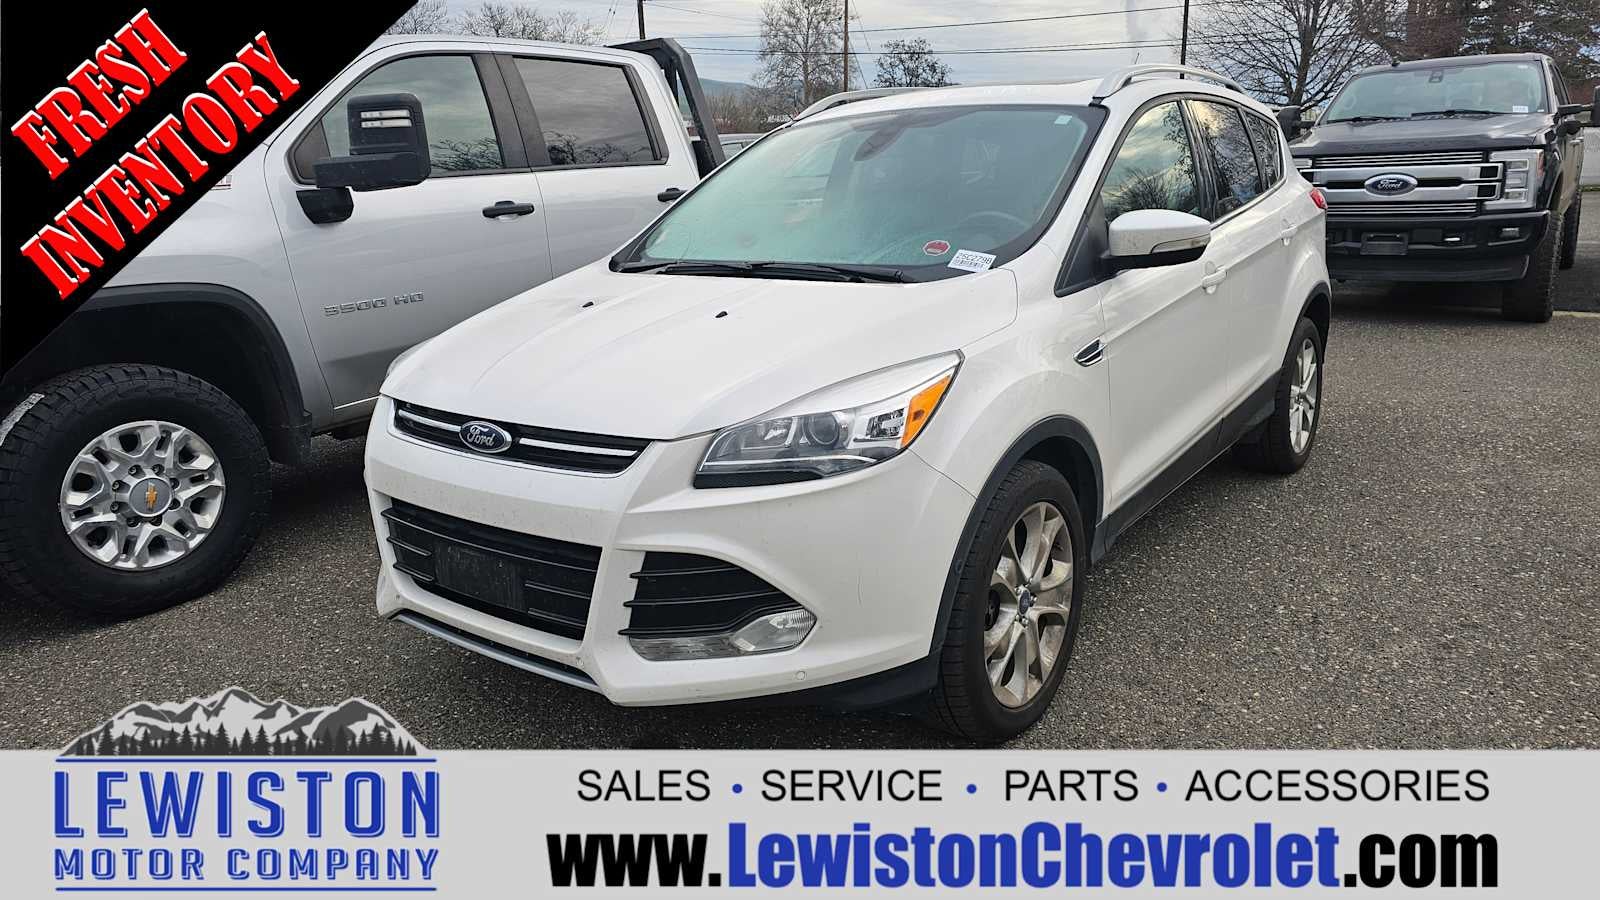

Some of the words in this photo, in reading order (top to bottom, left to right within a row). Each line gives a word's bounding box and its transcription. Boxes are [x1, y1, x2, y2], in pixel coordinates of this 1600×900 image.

[1377, 179, 1404, 190] Ford
[323, 297, 387, 317] 3500
[393, 291, 424, 306] HD
[467, 425, 495, 446] Ford
